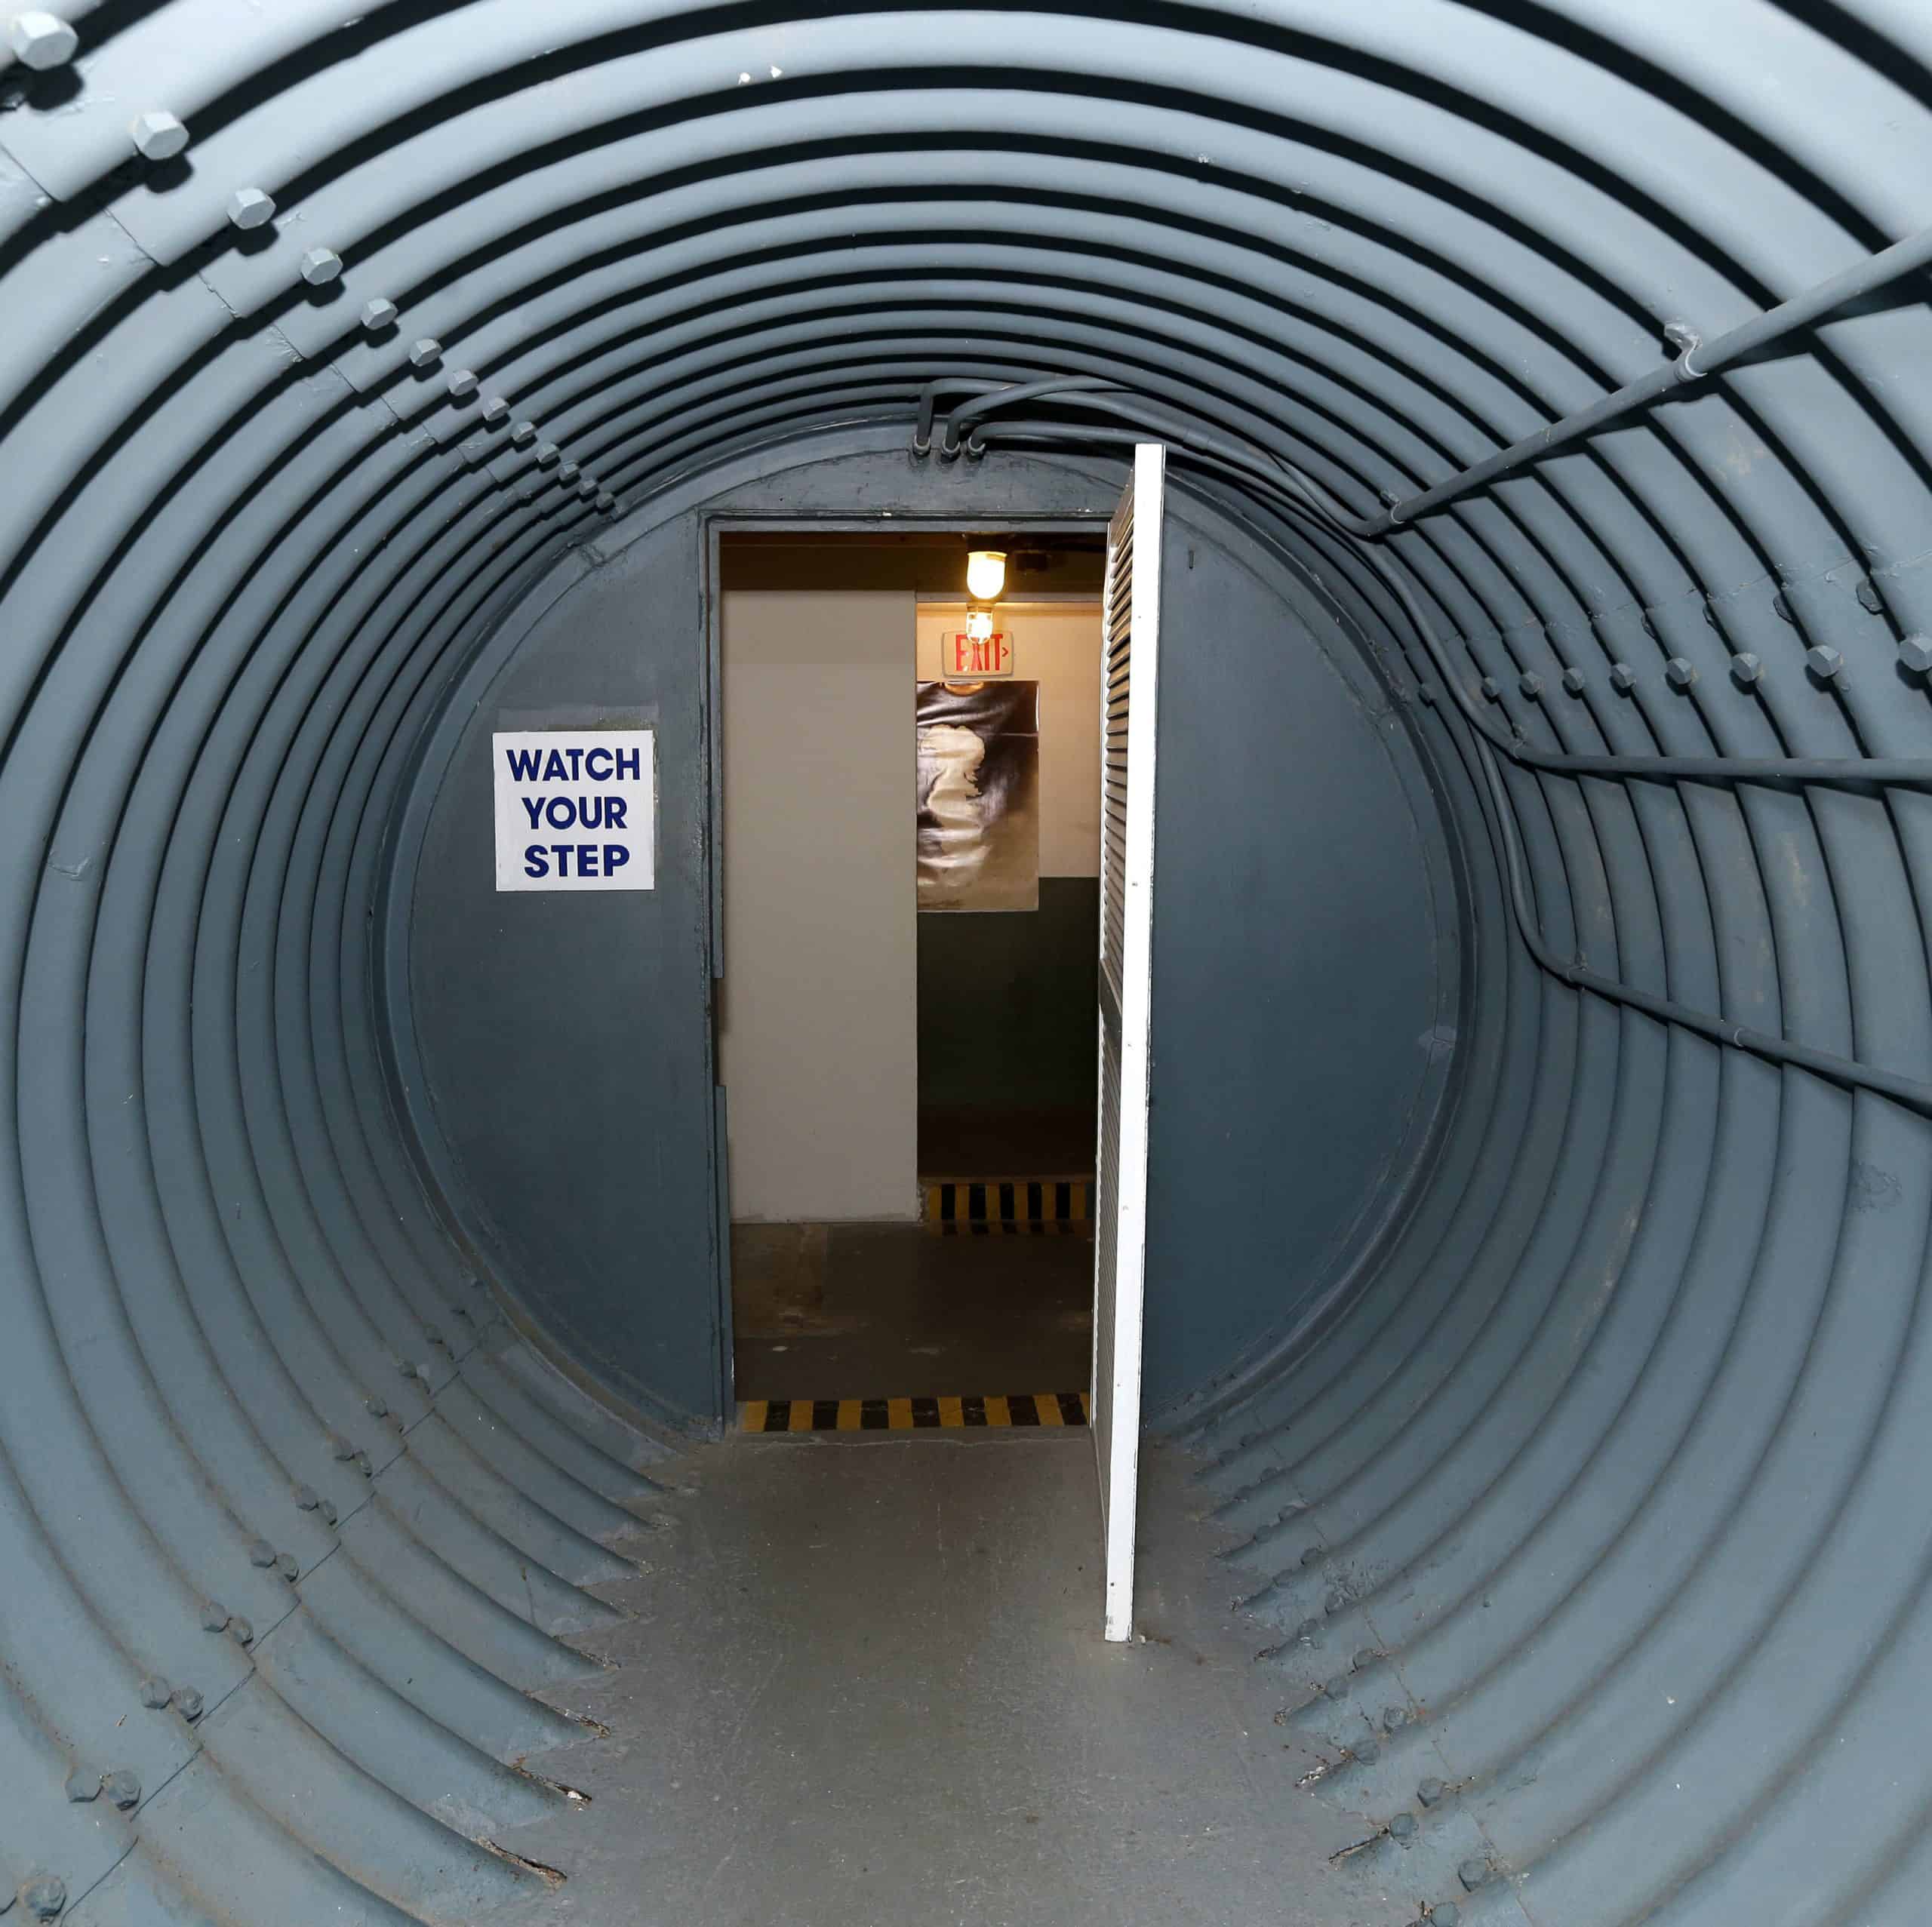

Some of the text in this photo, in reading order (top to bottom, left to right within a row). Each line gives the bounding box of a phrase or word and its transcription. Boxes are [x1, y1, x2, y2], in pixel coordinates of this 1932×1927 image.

[955, 633, 1003, 671] EXIT
[506, 748, 641, 782] WATCH
[521, 796, 628, 830] YOUR
[524, 844, 630, 878] STEP
